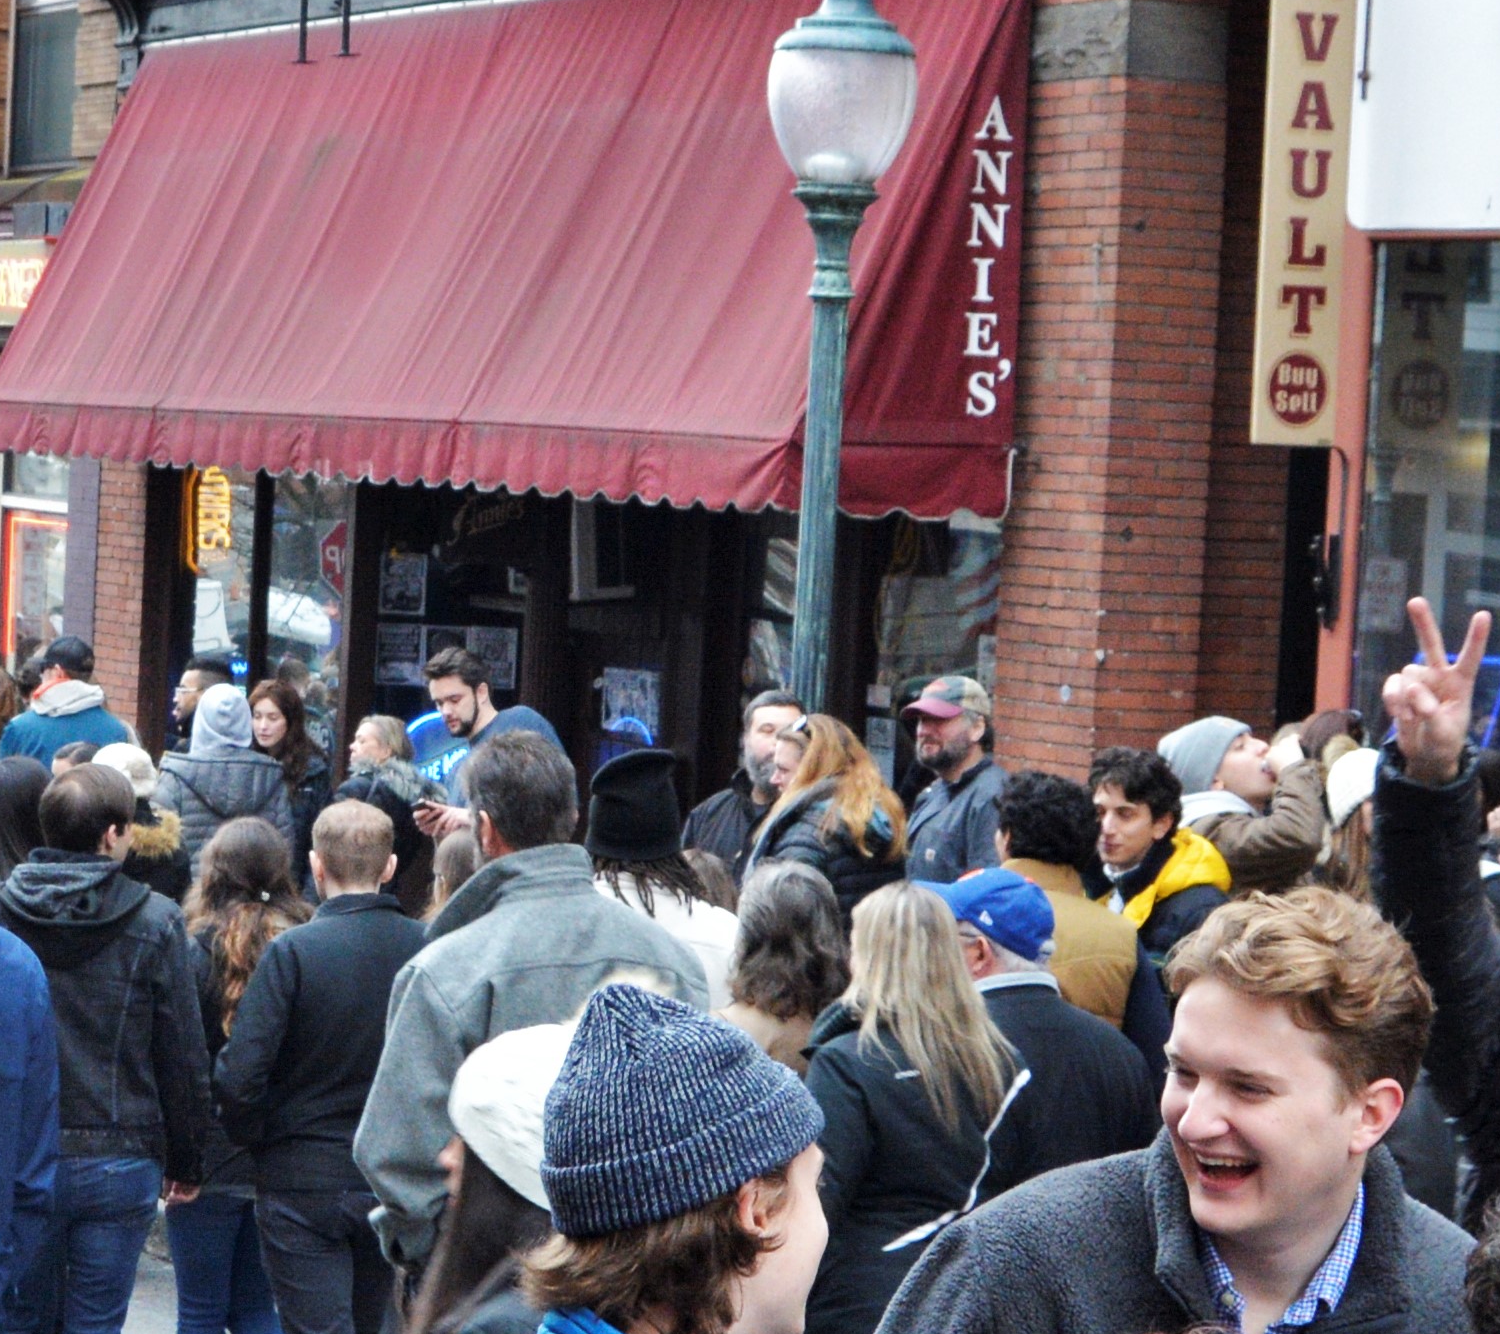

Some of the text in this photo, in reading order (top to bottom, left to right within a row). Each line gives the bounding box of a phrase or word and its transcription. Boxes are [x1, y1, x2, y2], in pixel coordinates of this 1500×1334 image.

[963, 94, 1014, 417] ANNIE'S
[1280, 12, 1340, 339] VAULT
[1274, 388, 1319, 415] Sell
[1276, 361, 1319, 390] Buy
